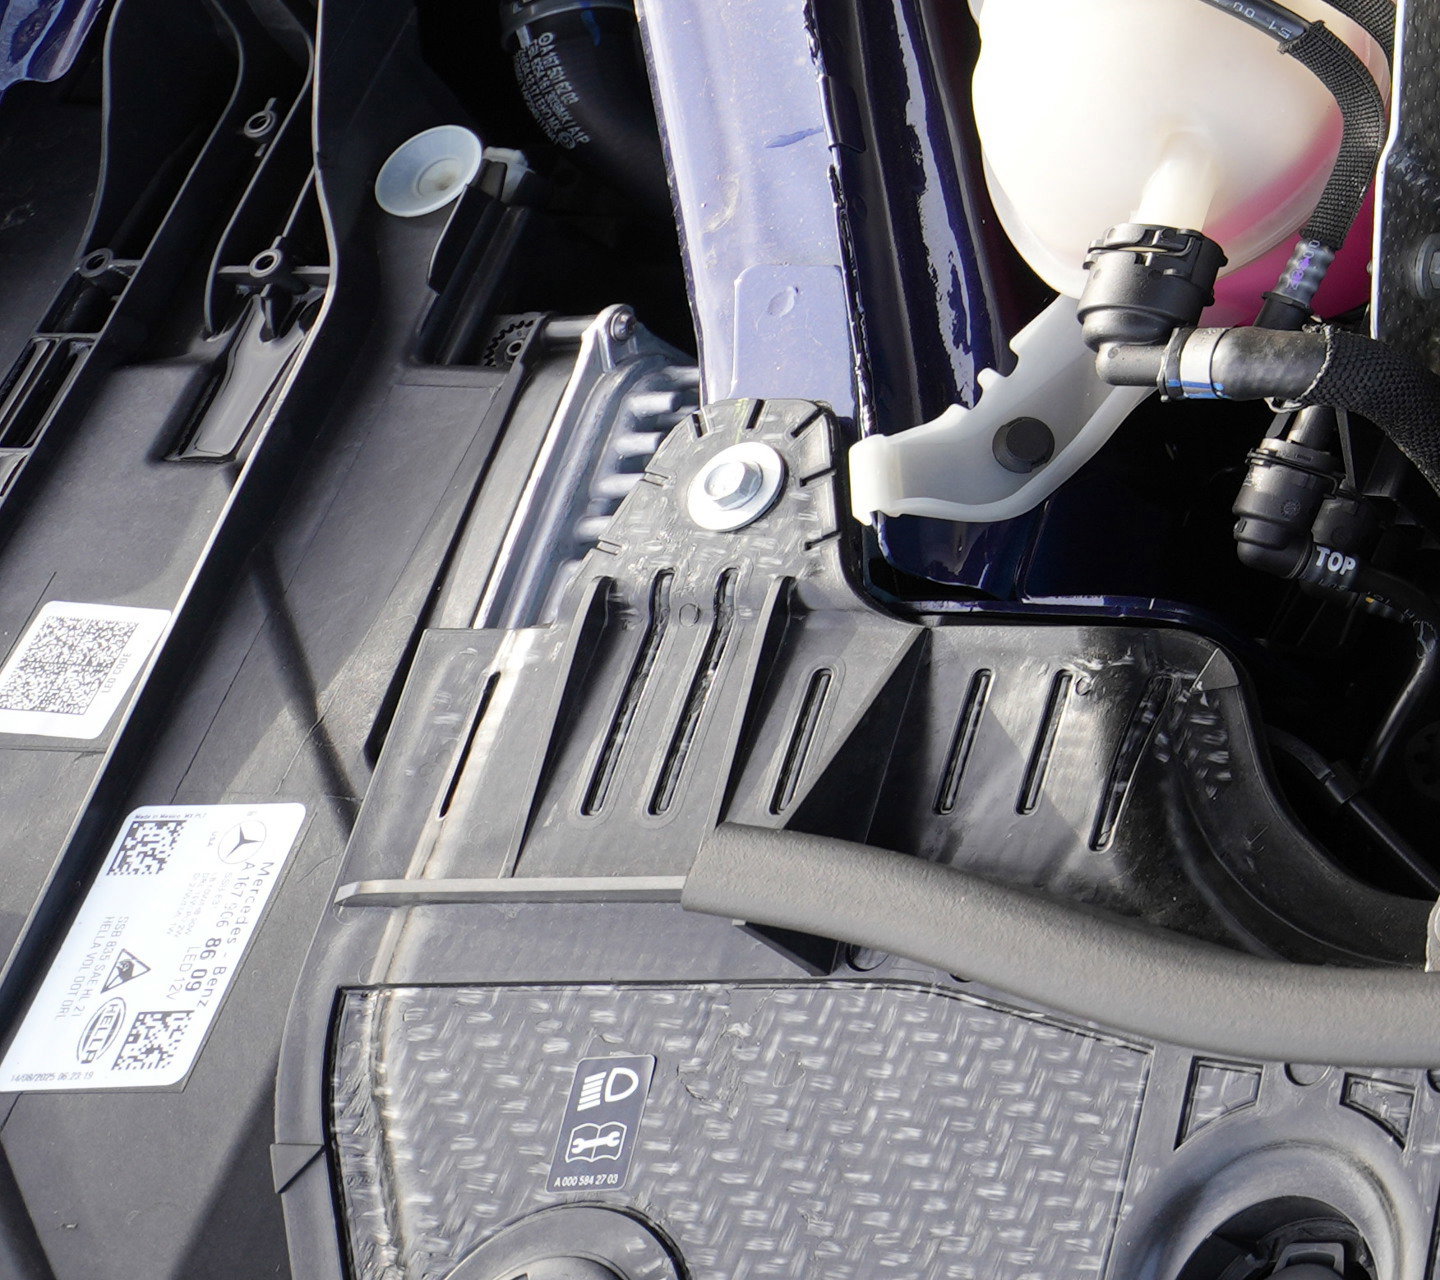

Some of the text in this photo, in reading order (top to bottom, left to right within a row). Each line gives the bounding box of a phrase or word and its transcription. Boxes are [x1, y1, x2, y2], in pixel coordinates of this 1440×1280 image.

[1315, 546, 1357, 576] TOP
[238, 861, 256, 872] A
[227, 875, 251, 897] 167
[223, 860, 276, 945] Mercedes
[87, 914, 116, 950] HELLA
[175, 945, 201, 973] LED
[196, 936, 223, 961] 86
[162, 976, 187, 1002] 12V
[182, 967, 209, 992] 09
[194, 965, 228, 1008] Benz
[78, 1002, 121, 1065] HELLA
[553, 1174, 619, 1187] A 000 584 27 03
